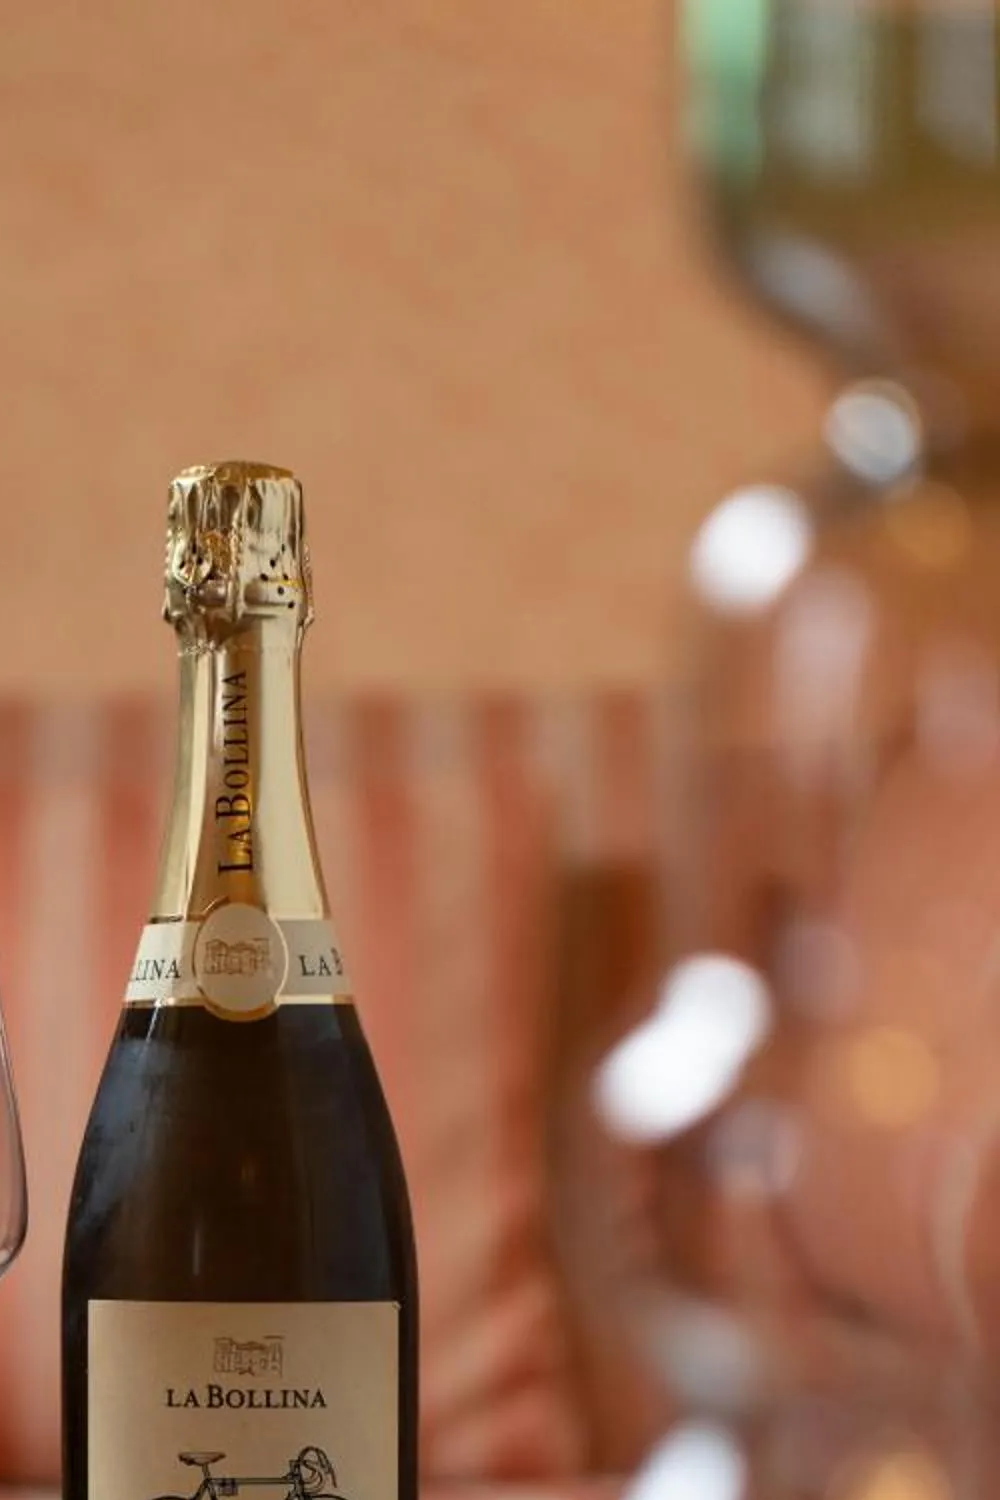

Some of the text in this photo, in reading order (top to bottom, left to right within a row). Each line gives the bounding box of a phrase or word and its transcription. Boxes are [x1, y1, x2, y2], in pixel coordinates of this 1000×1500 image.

[216, 671, 250, 823] BOLLINA
[166, 1384, 327, 1409] LA BOLLINA
